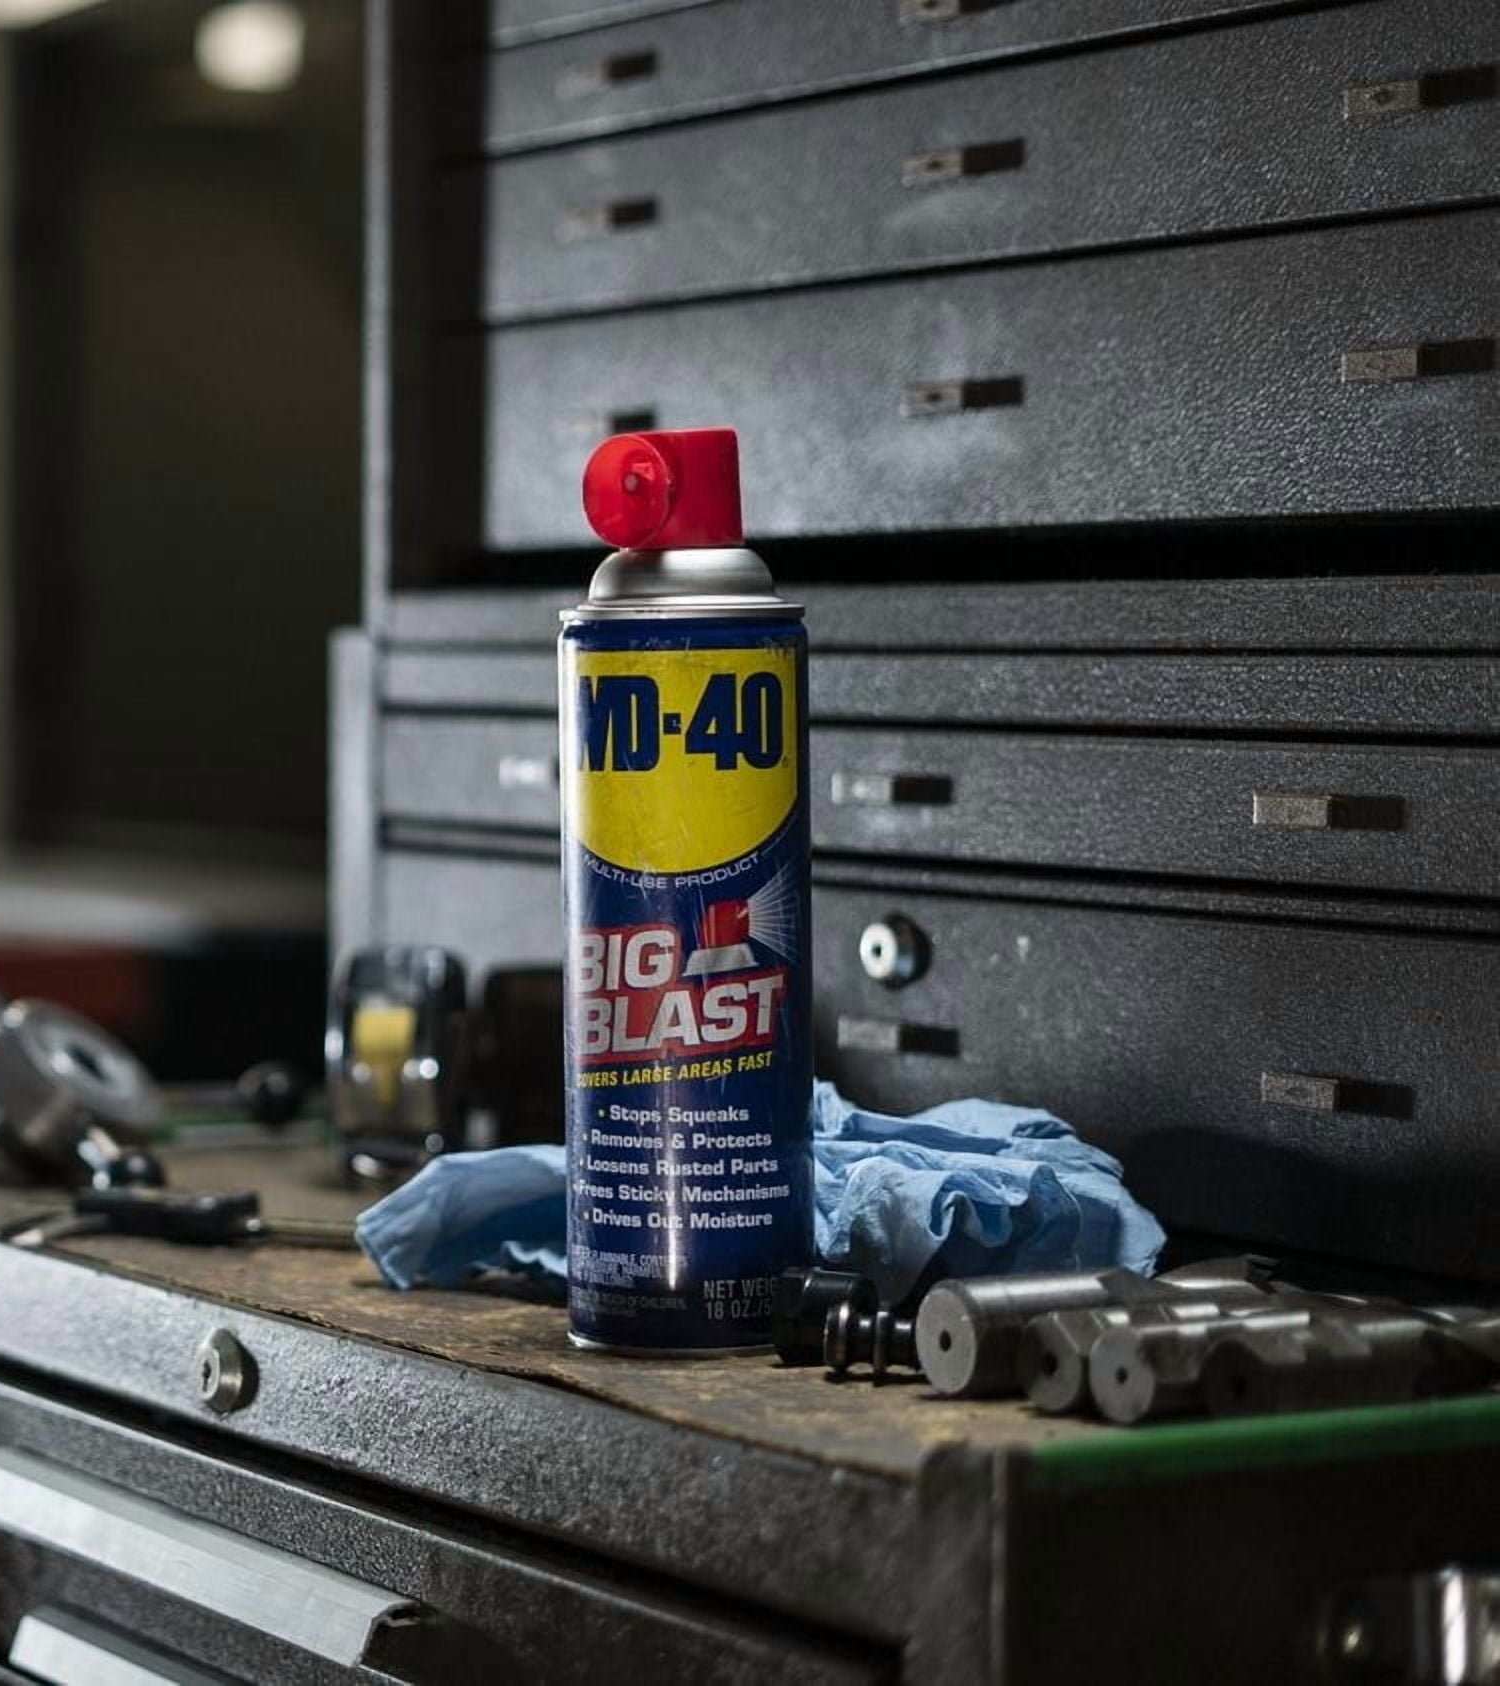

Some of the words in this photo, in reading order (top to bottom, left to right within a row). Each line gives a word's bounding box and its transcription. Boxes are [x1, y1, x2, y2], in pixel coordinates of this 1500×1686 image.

[675, 851, 760, 888] PRODUCT
[579, 930, 675, 993] BIG
[579, 974, 784, 1054] BLAST
[623, 1066, 672, 1084] LARGE
[678, 1059, 732, 1079] AREAS
[737, 1051, 773, 1071] FAST
[610, 1105, 661, 1125] Stops
[668, 1106, 749, 1126] Squeaks
[591, 1129, 663, 1149] Removes
[671, 1134, 685, 1149] &
[693, 1132, 772, 1149] Protects
[587, 1155, 649, 1174] Loosens
[656, 1158, 724, 1175] Rusted
[731, 1158, 778, 1174] Parts
[579, 1179, 613, 1199] Frees
[619, 1184, 677, 1206] Sticky
[682, 1183, 790, 1202] Mechanisms
[592, 1208, 641, 1227] Drives
[648, 1212, 683, 1229] Out
[690, 1211, 772, 1229] Moisture
[703, 1279, 736, 1299] NET
[706, 1300, 725, 1321] 18
